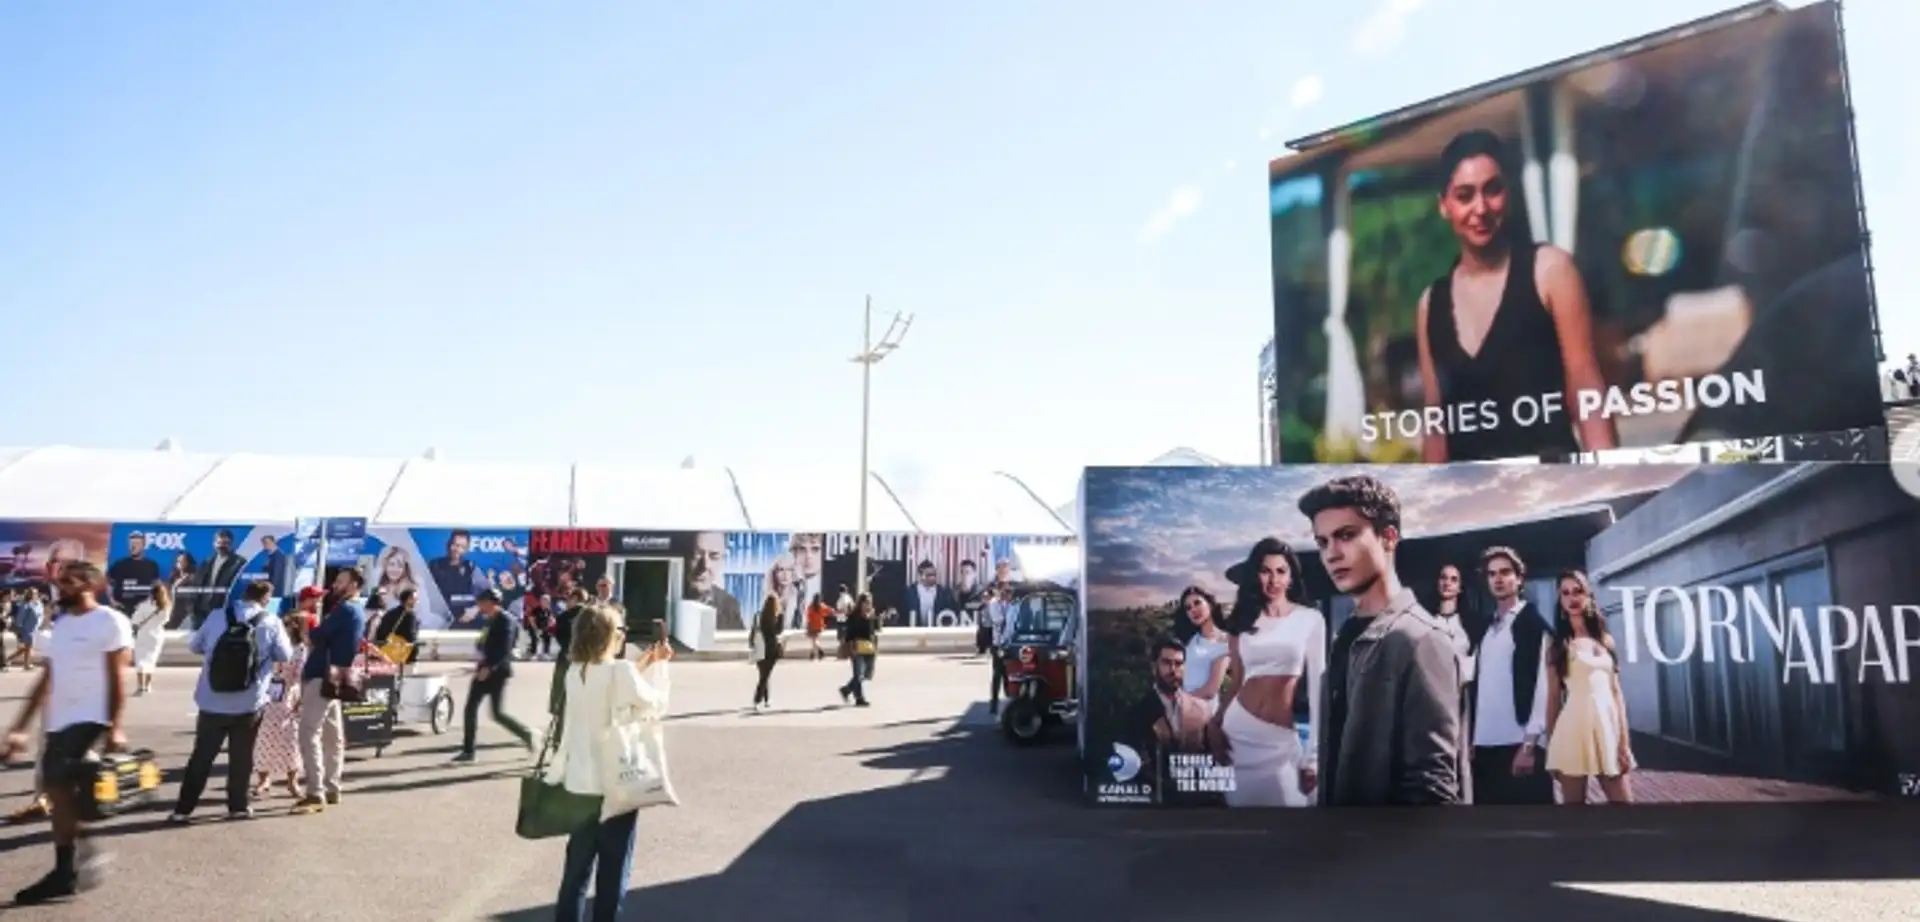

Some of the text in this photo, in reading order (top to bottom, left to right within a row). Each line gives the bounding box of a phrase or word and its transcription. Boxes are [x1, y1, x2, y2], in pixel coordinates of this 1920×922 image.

[1361, 369, 1767, 440] STORIES OF PASSION
[145, 532, 187, 550] FOX
[470, 536, 506, 552] FOX
[531, 529, 609, 552] FEARLESS
[825, 533, 904, 560] DEFANT
[1607, 584, 1784, 665] TORN
[1098, 784, 1152, 794] KANAL D
